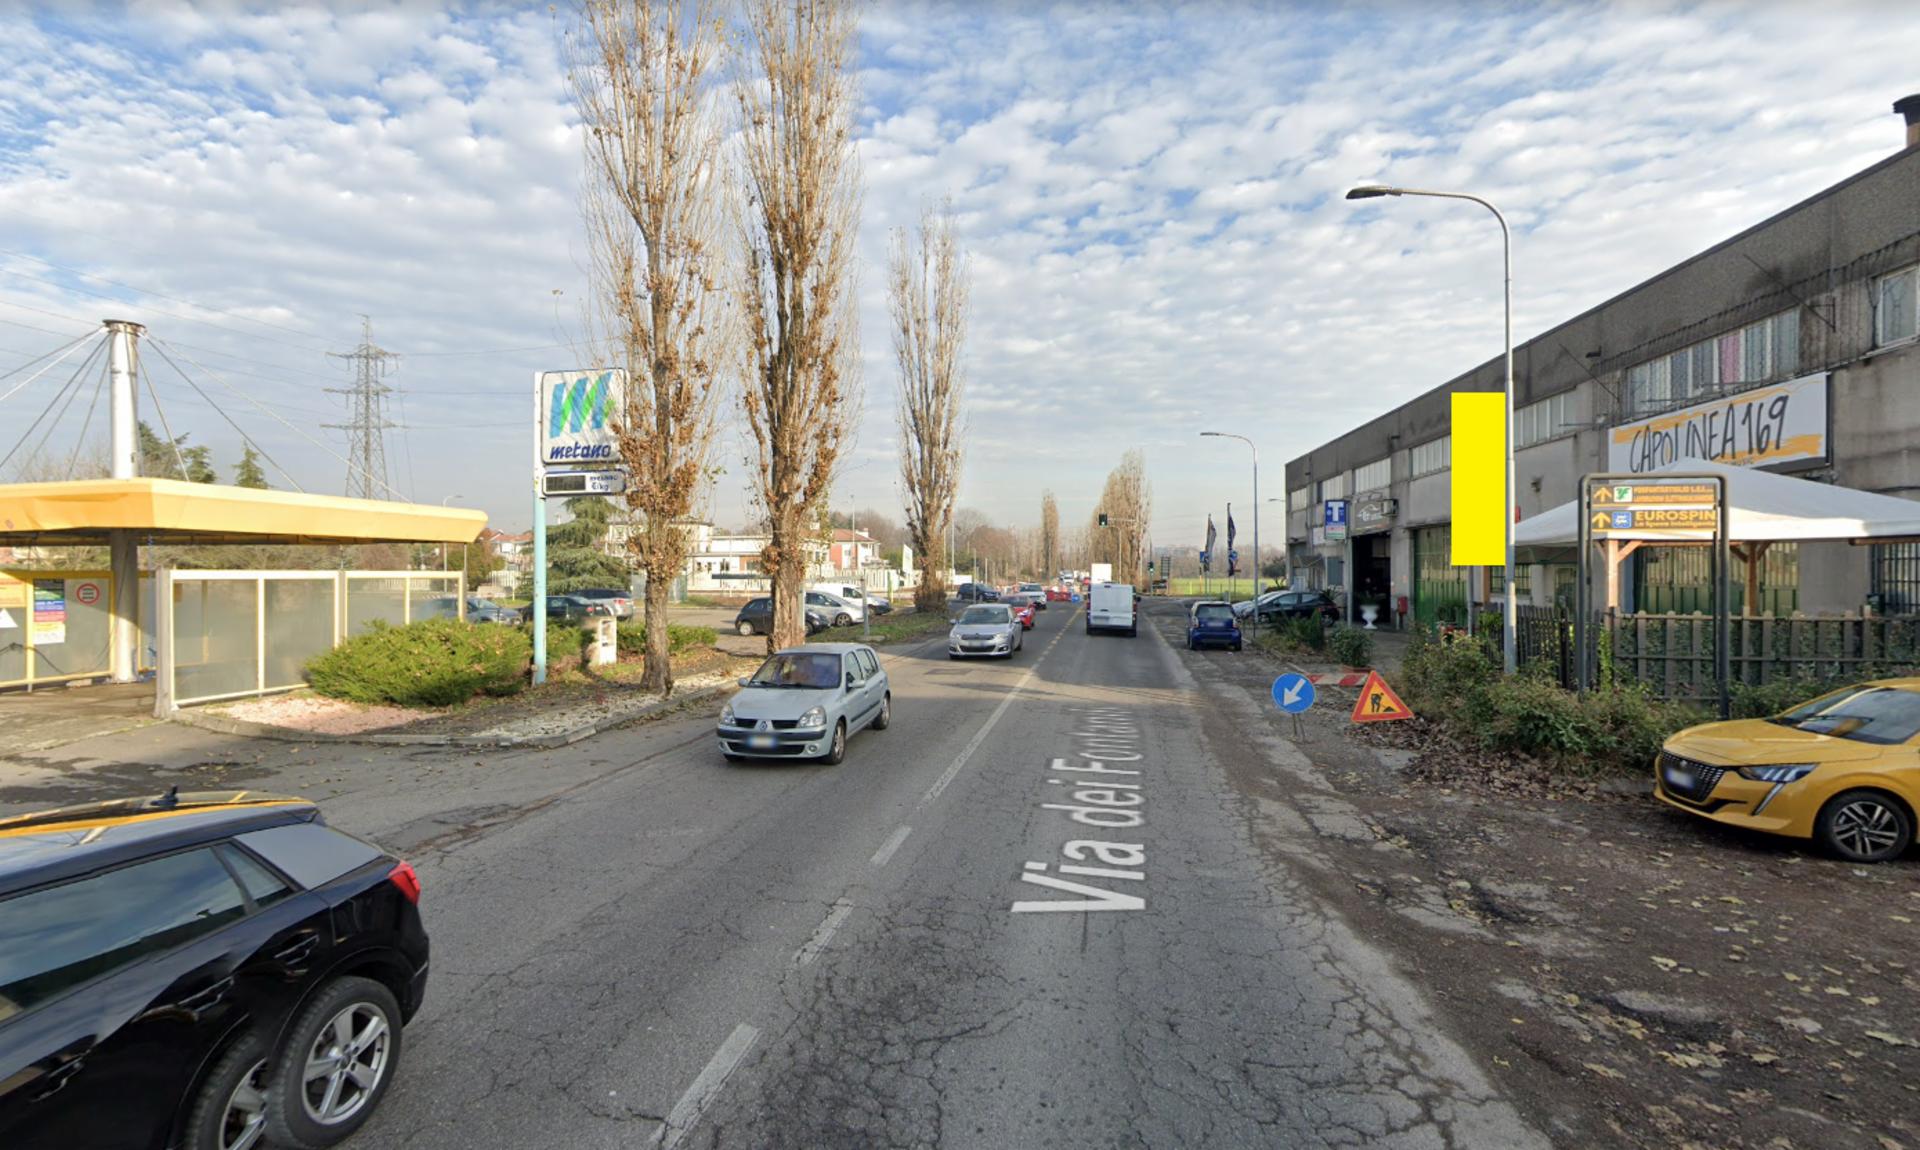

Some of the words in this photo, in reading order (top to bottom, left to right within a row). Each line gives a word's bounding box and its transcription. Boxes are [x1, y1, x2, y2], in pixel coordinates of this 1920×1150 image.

[1741, 395, 1789, 455] 169
[550, 442, 611, 459] metano
[1328, 501, 1345, 521] T
[1635, 510, 1716, 521] EUROSPIN
